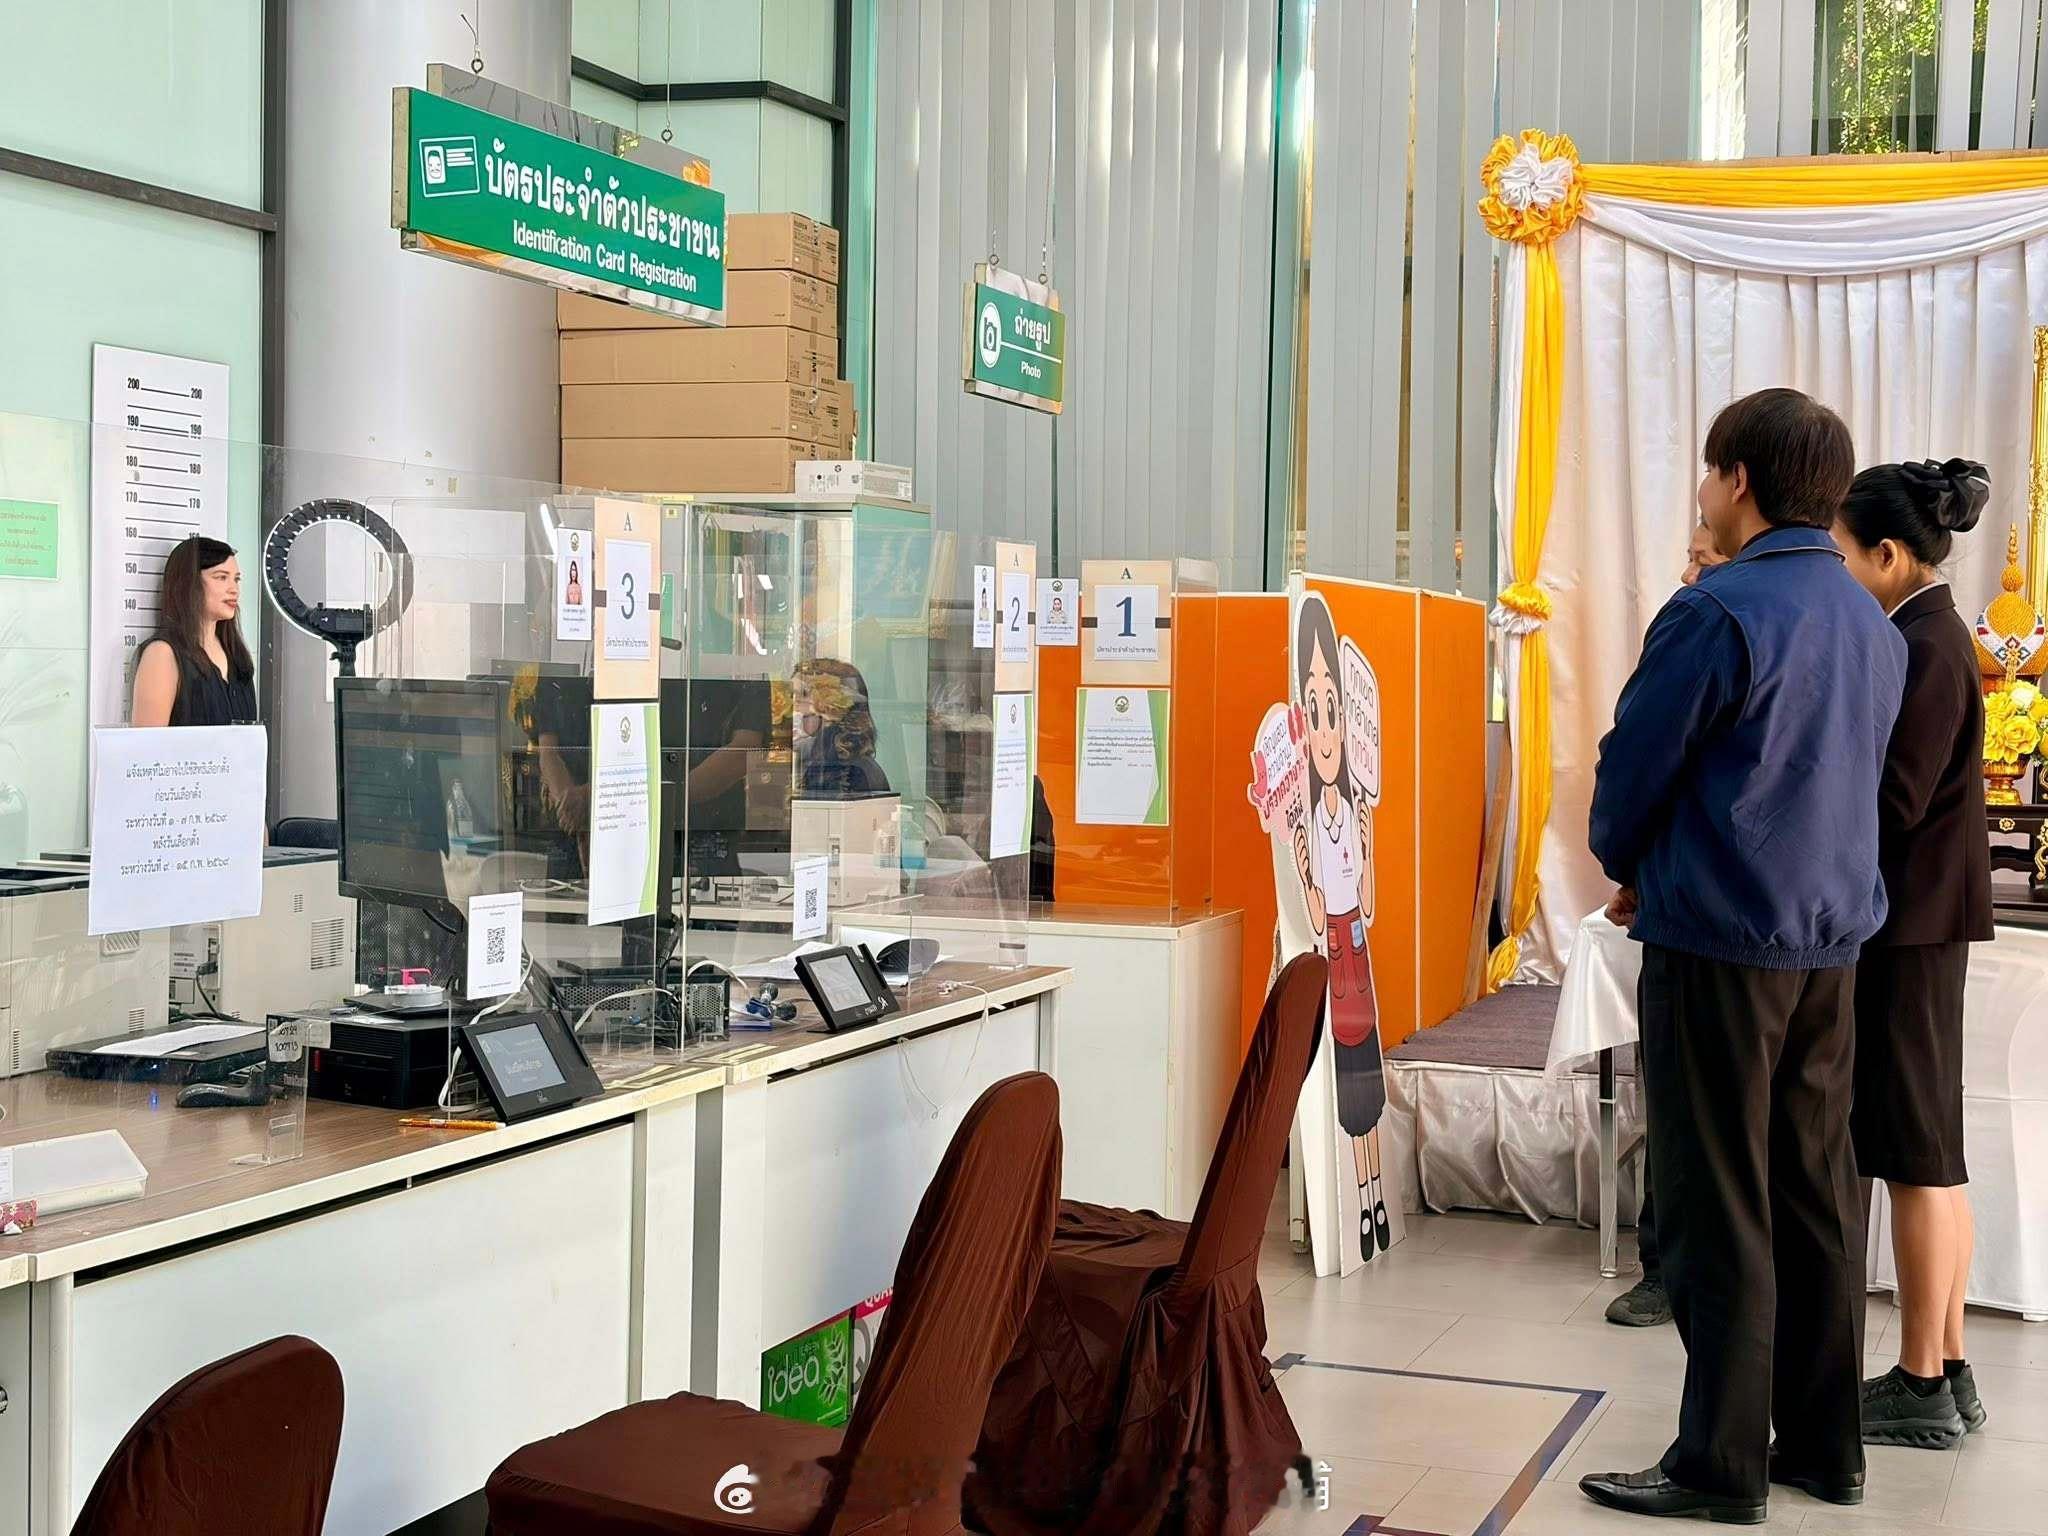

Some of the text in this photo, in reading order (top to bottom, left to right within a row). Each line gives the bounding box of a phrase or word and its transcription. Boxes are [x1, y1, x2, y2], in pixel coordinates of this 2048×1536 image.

[484, 137, 721, 261] บัตรประจำตัวประชาชน
[513, 219, 697, 292] Identification Card Registration
[1014, 308, 1051, 352] ถ่ายรูป
[1021, 361, 1042, 379] Photo
[127, 377, 202, 400] 200 200
[127, 415, 202, 435] 190 190
[126, 455, 201, 474] 180 180
[126, 491, 200, 509] 170 170
[624, 512, 632, 532] A
[125, 527, 137, 538] 160
[125, 563, 137, 574] 150
[1013, 553, 1019, 567] A
[1121, 567, 1132, 580] A
[125, 599, 136, 610] 140
[620, 572, 635, 620] 3
[1011, 597, 1020, 632] 2
[1116, 596, 1137, 637] 1
[124, 635, 136, 646] 130
[155, 782, 201, 801] ก่อนวันเลือกตั้ง
[126, 812, 167, 828] ระหว่างวันที่
[189, 814, 202, 825] ก.พ.
[153, 829, 200, 849] หลังวันเลือกตั้ง
[120, 858, 162, 875] ระหว่างวันที่
[190, 859, 203, 868] ก.พ.
[767, 1353, 820, 1407] idea
